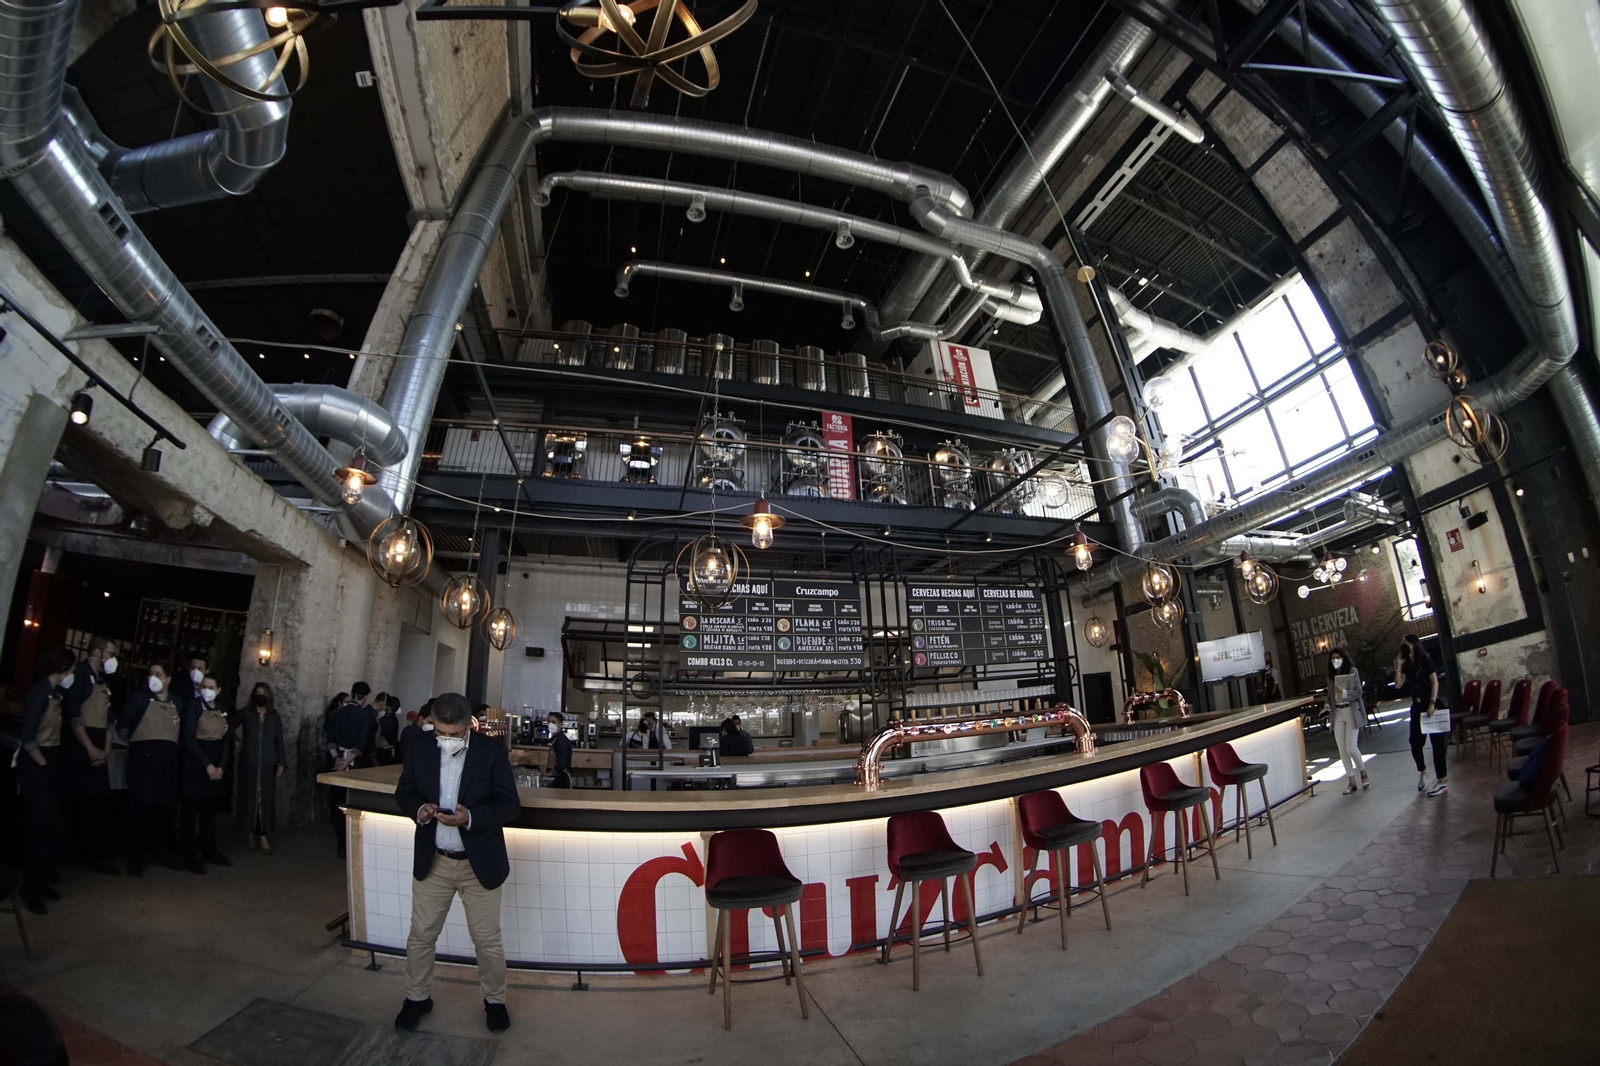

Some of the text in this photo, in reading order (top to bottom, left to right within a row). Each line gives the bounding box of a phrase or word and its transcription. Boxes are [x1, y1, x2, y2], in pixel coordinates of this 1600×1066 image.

[752, 584, 768, 594] AQUÍ
[796, 586, 839, 597] Cruzcampo
[912, 588, 976, 598] CERVEZAS HECHAS AQUÍ
[983, 589, 1034, 598] CERVEZAS DE BARRIL
[710, 616, 735, 624] DESCARÁ
[795, 619, 820, 627] FLAMA
[1291, 606, 1359, 640] STA CERVEZA
[704, 634, 736, 645] MIJITA
[796, 636, 826, 645] DUENDE
[929, 634, 950, 644] FETÉN
[1221, 646, 1251, 660] FACTORÍA
[687, 657, 708, 666] COMBO
[709, 658, 725, 666] 4X13
[1298, 656, 1316, 679] QUÍ
